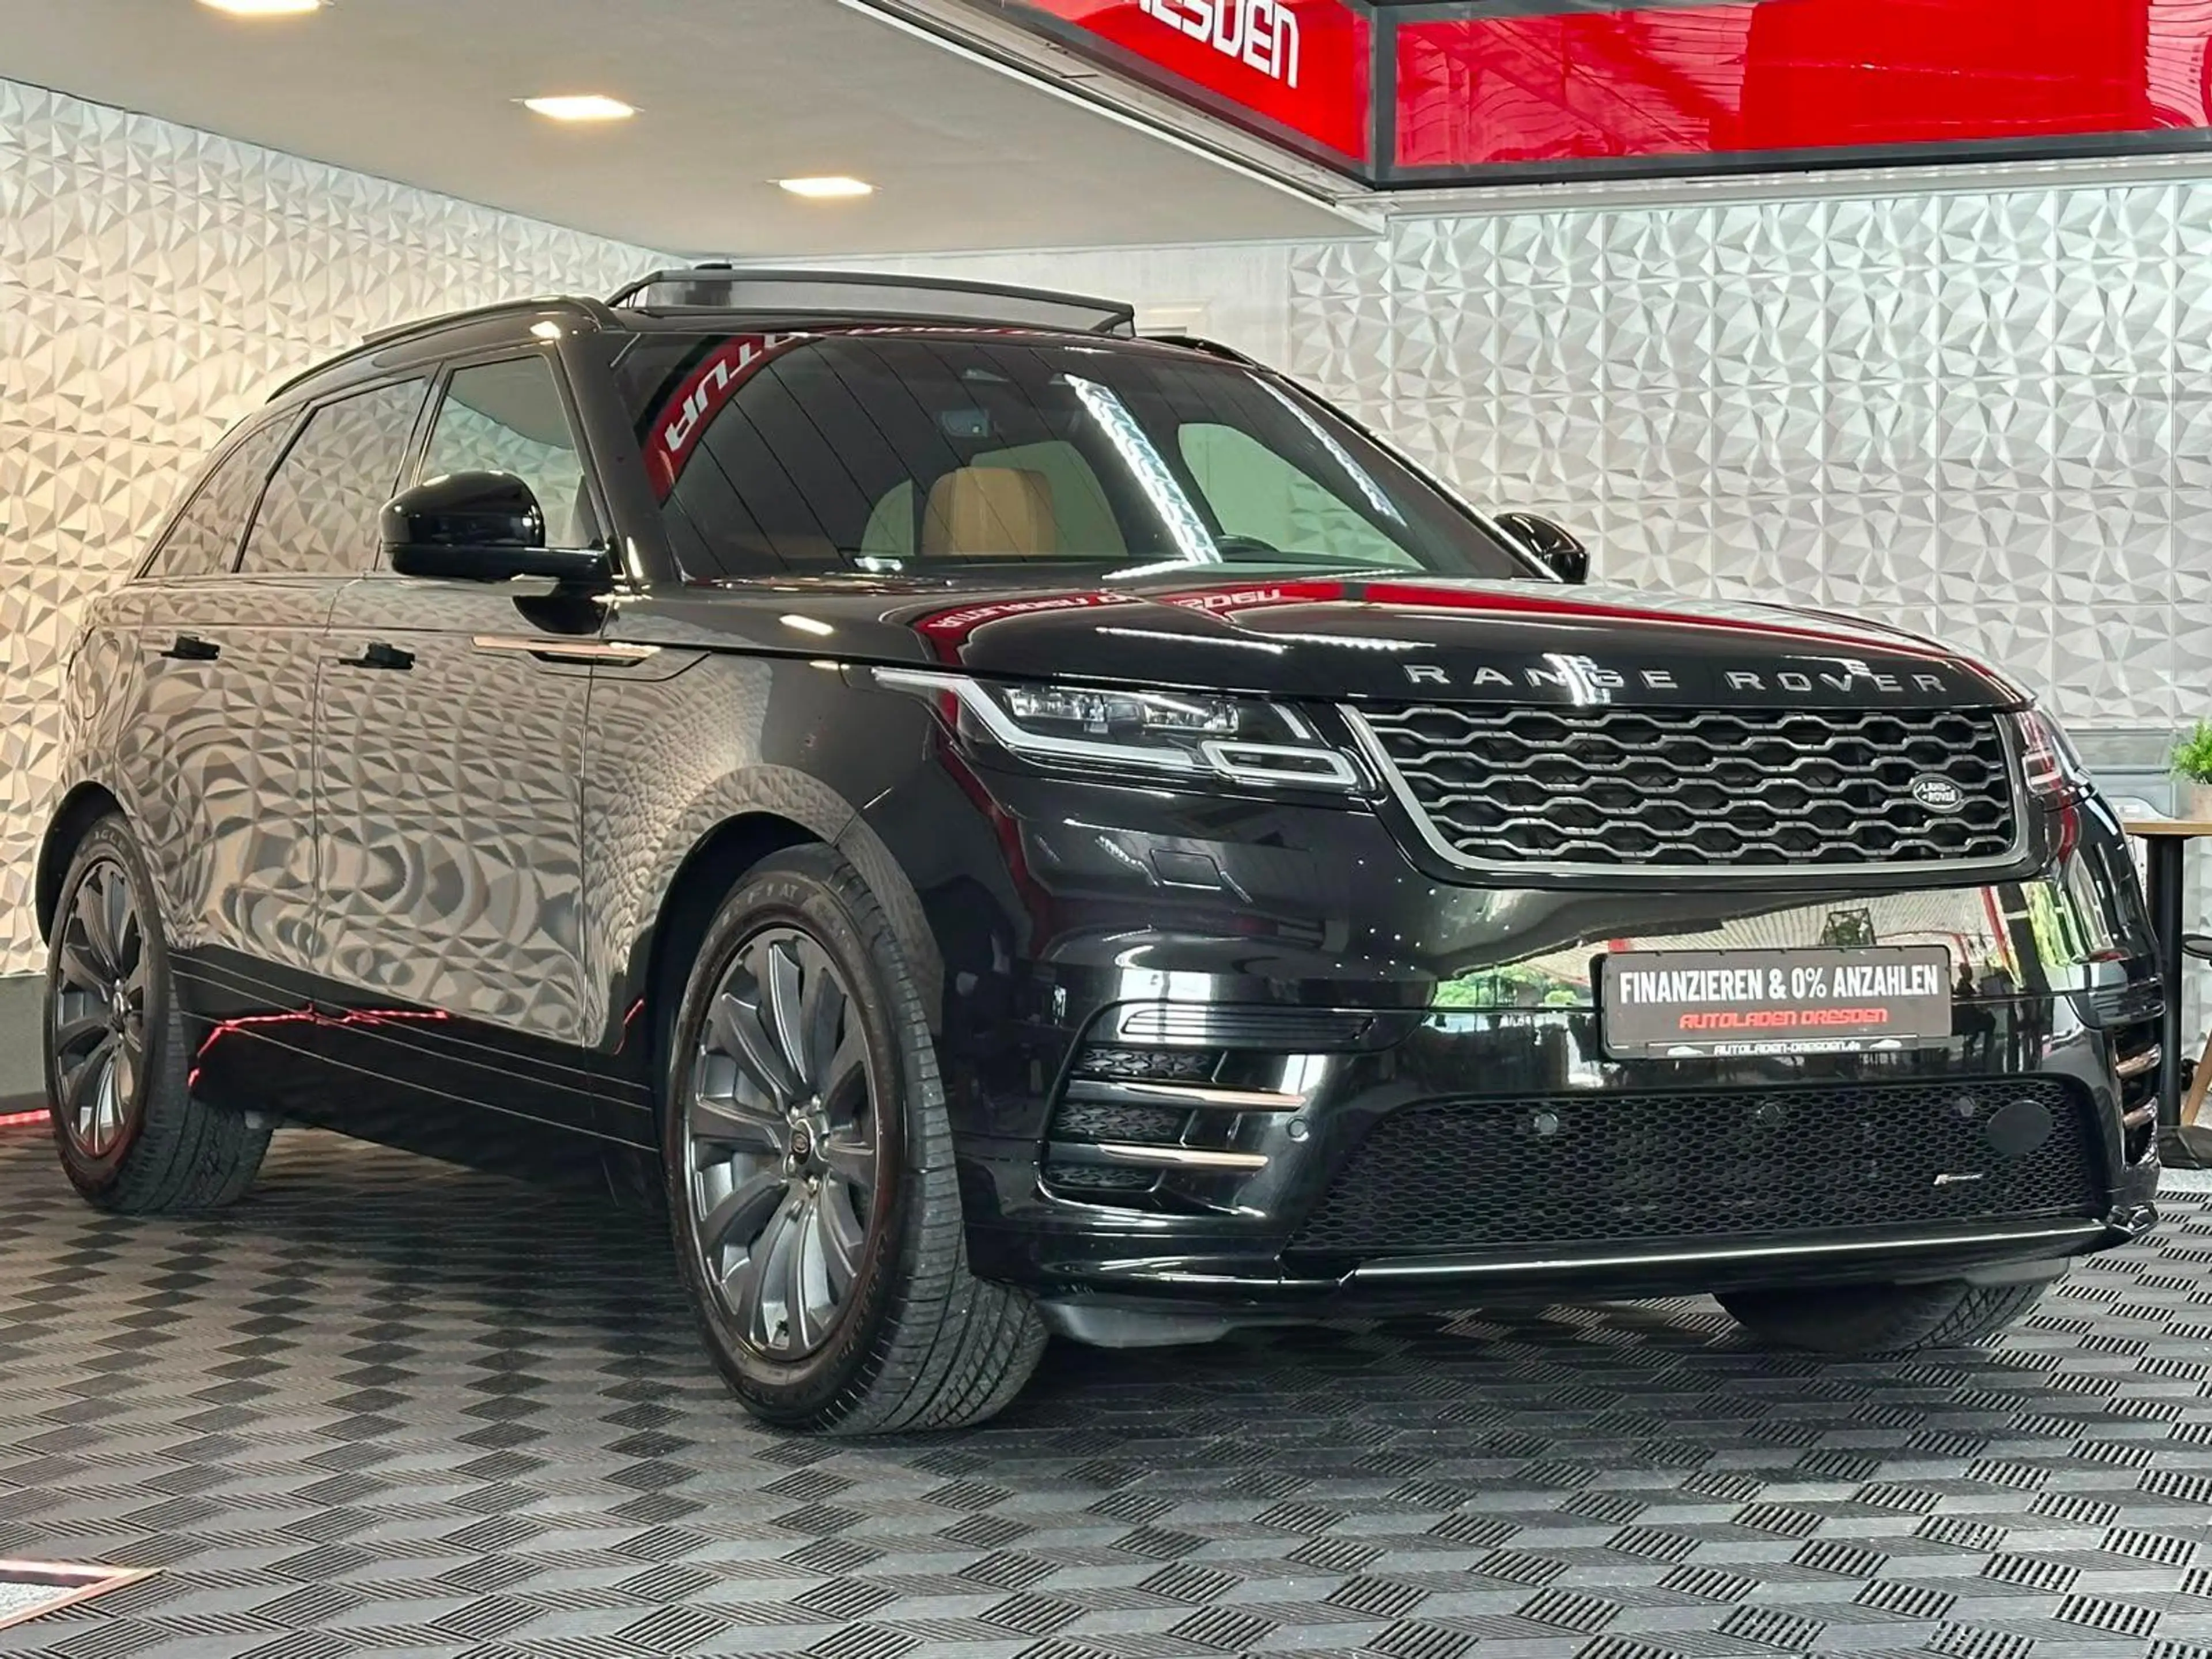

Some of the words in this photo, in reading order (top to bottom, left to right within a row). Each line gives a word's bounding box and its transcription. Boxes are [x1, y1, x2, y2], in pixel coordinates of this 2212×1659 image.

[1404, 664, 1678, 688] RANGE
[1724, 671, 1947, 692] ROVER
[1620, 968, 1763, 1003] FINANZIEREN
[1768, 968, 1787, 1000] &
[1791, 967, 1827, 999] 0%
[1832, 964, 1938, 998] ANZAHLEN
[1679, 1010, 1796, 1029] AUTOLADEN
[1800, 1008, 1888, 1025] DRESDEN
